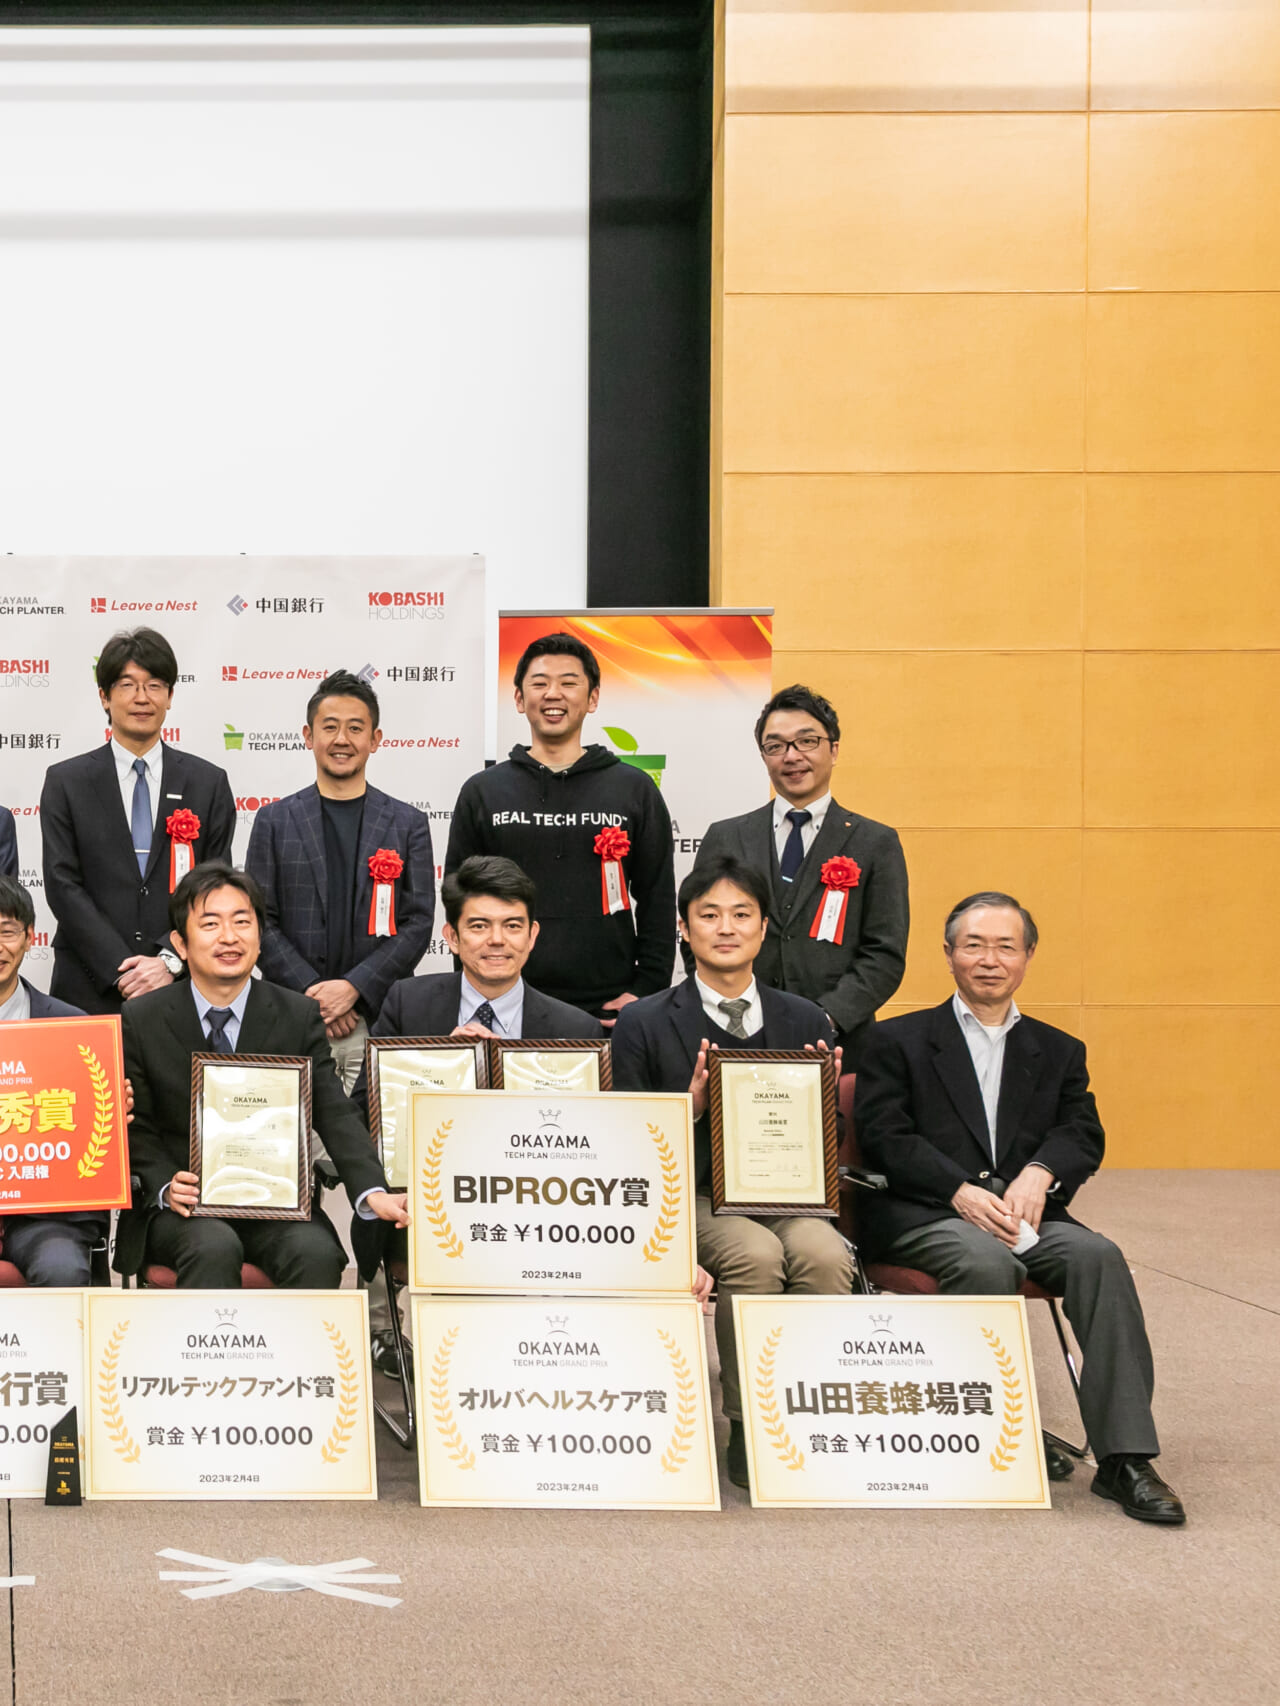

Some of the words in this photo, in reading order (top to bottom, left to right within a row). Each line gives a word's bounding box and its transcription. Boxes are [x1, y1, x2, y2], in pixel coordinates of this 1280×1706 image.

[111, 600, 151, 610] Leave
[153, 603, 163, 611] a
[166, 600, 197, 611] Nest
[256, 598, 322, 613] 中国銀行
[368, 592, 443, 606] KOBASHI
[368, 606, 445, 620] HOLDINGS
[242, 669, 284, 679] Leave
[286, 671, 294, 679] a
[297, 669, 328, 680] Nest
[388, 666, 454, 681] 中国銀行
[249, 733, 300, 741] OKAYAMA
[428, 737, 460, 747] Nest
[493, 811, 530, 826] REAL
[16, 1077, 33, 1085] PRIX
[511, 1135, 590, 1148] OKAYAMA
[550, 1152, 577, 1160] GRAND
[7, 1165, 49, 1180] 入居権
[454, 1176, 649, 1207] BIPROGY賞
[470, 1223, 507, 1241] 賞金
[515, 1224, 635, 1244] ¥100,000
[522, 1271, 581, 1279] 2023年2月4日
[187, 1335, 266, 1348] OKAYAMA
[843, 1341, 925, 1354] OKAYAMA
[519, 1342, 600, 1355] OKAYAMA
[204, 1352, 224, 1360] PLAN
[512, 1359, 534, 1367] TECH
[536, 1359, 558, 1368] PLAN
[123, 1376, 335, 1398] リアルテックファンド賞
[459, 1388, 667, 1413] オルバヘルスケア賞
[786, 1381, 994, 1416] 山田養蜂場賞
[147, 1426, 184, 1445] 賞金
[192, 1426, 312, 1445] ¥100,000
[481, 1434, 520, 1453] 賞金
[527, 1434, 651, 1454] ¥100,000
[810, 1434, 848, 1453] 賞金
[855, 1434, 979, 1453] ¥100,000
[537, 1483, 598, 1491] 2023年2月4日
[867, 1483, 928, 1491] 2023年2月4日
